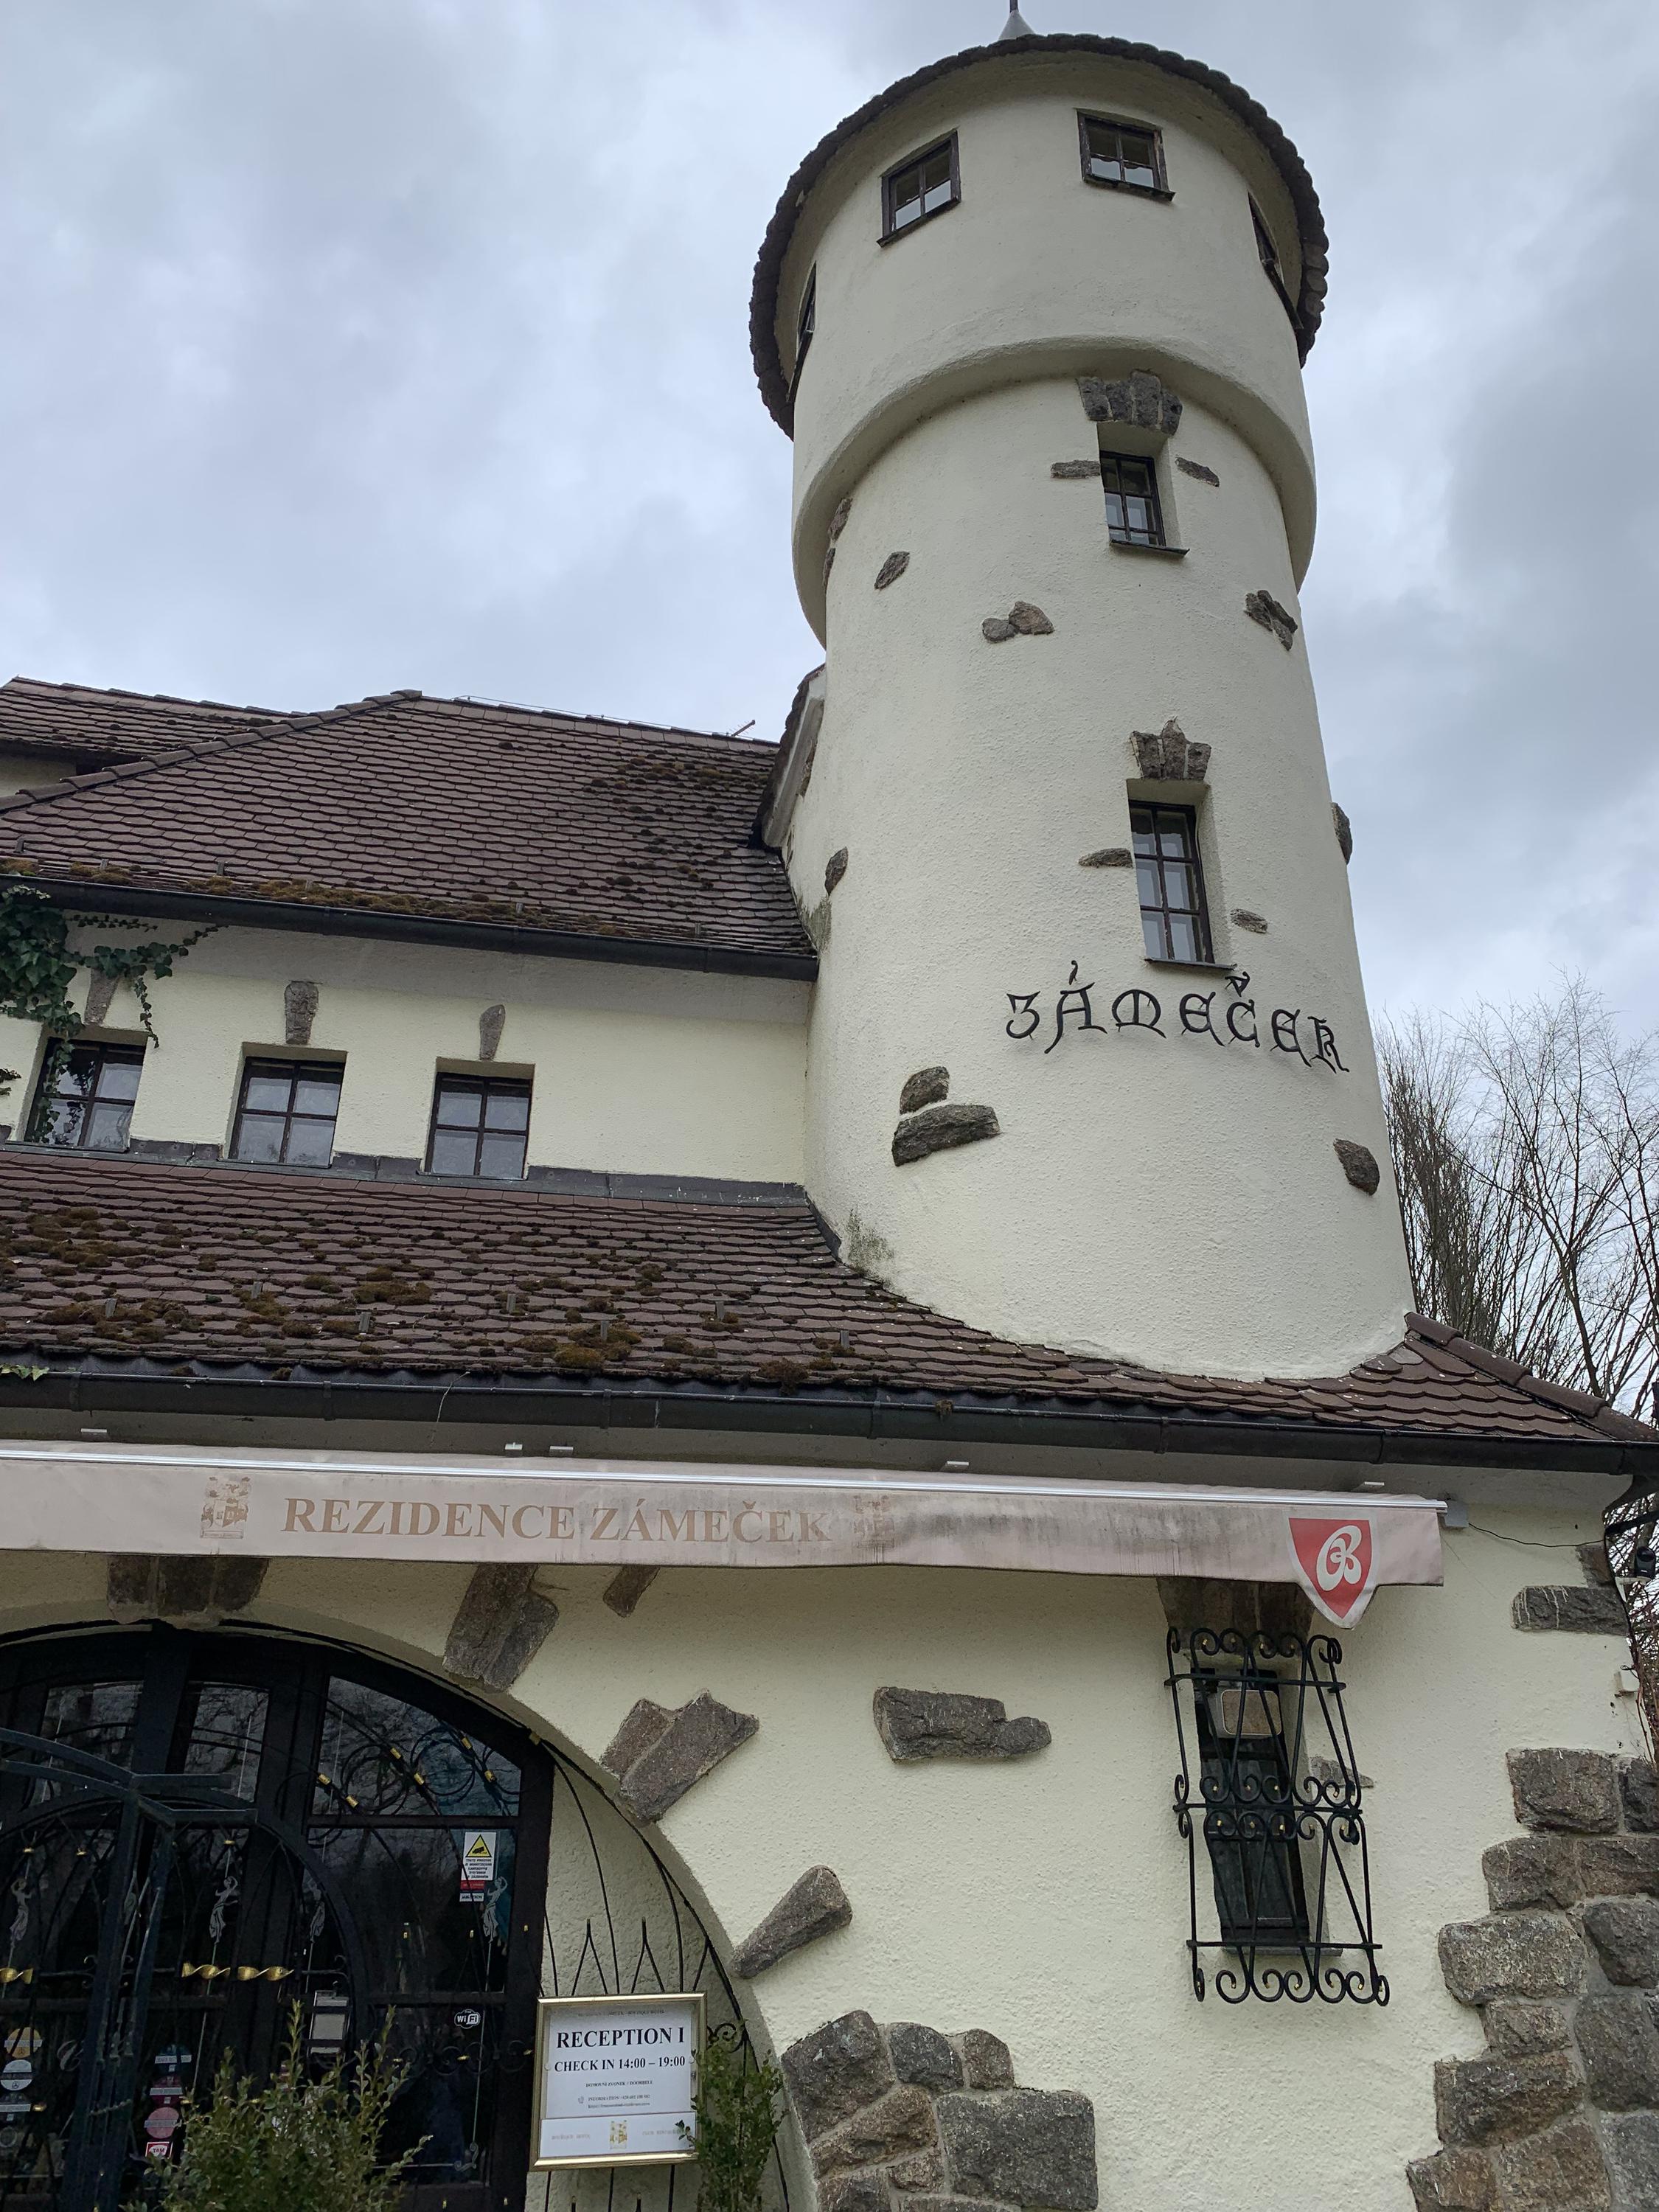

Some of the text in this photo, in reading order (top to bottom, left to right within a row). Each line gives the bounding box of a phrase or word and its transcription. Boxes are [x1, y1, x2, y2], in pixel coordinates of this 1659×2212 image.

[280, 1498, 833, 1543] REZIDENCE ZÁMEČEK
[557, 2027, 684, 2048] RECEPTION I
[554, 2060, 599, 2072] CHECK
[602, 2059, 615, 2070] IN
[619, 2057, 646, 2069] 14:00
[658, 2056, 685, 2067] 19:00
